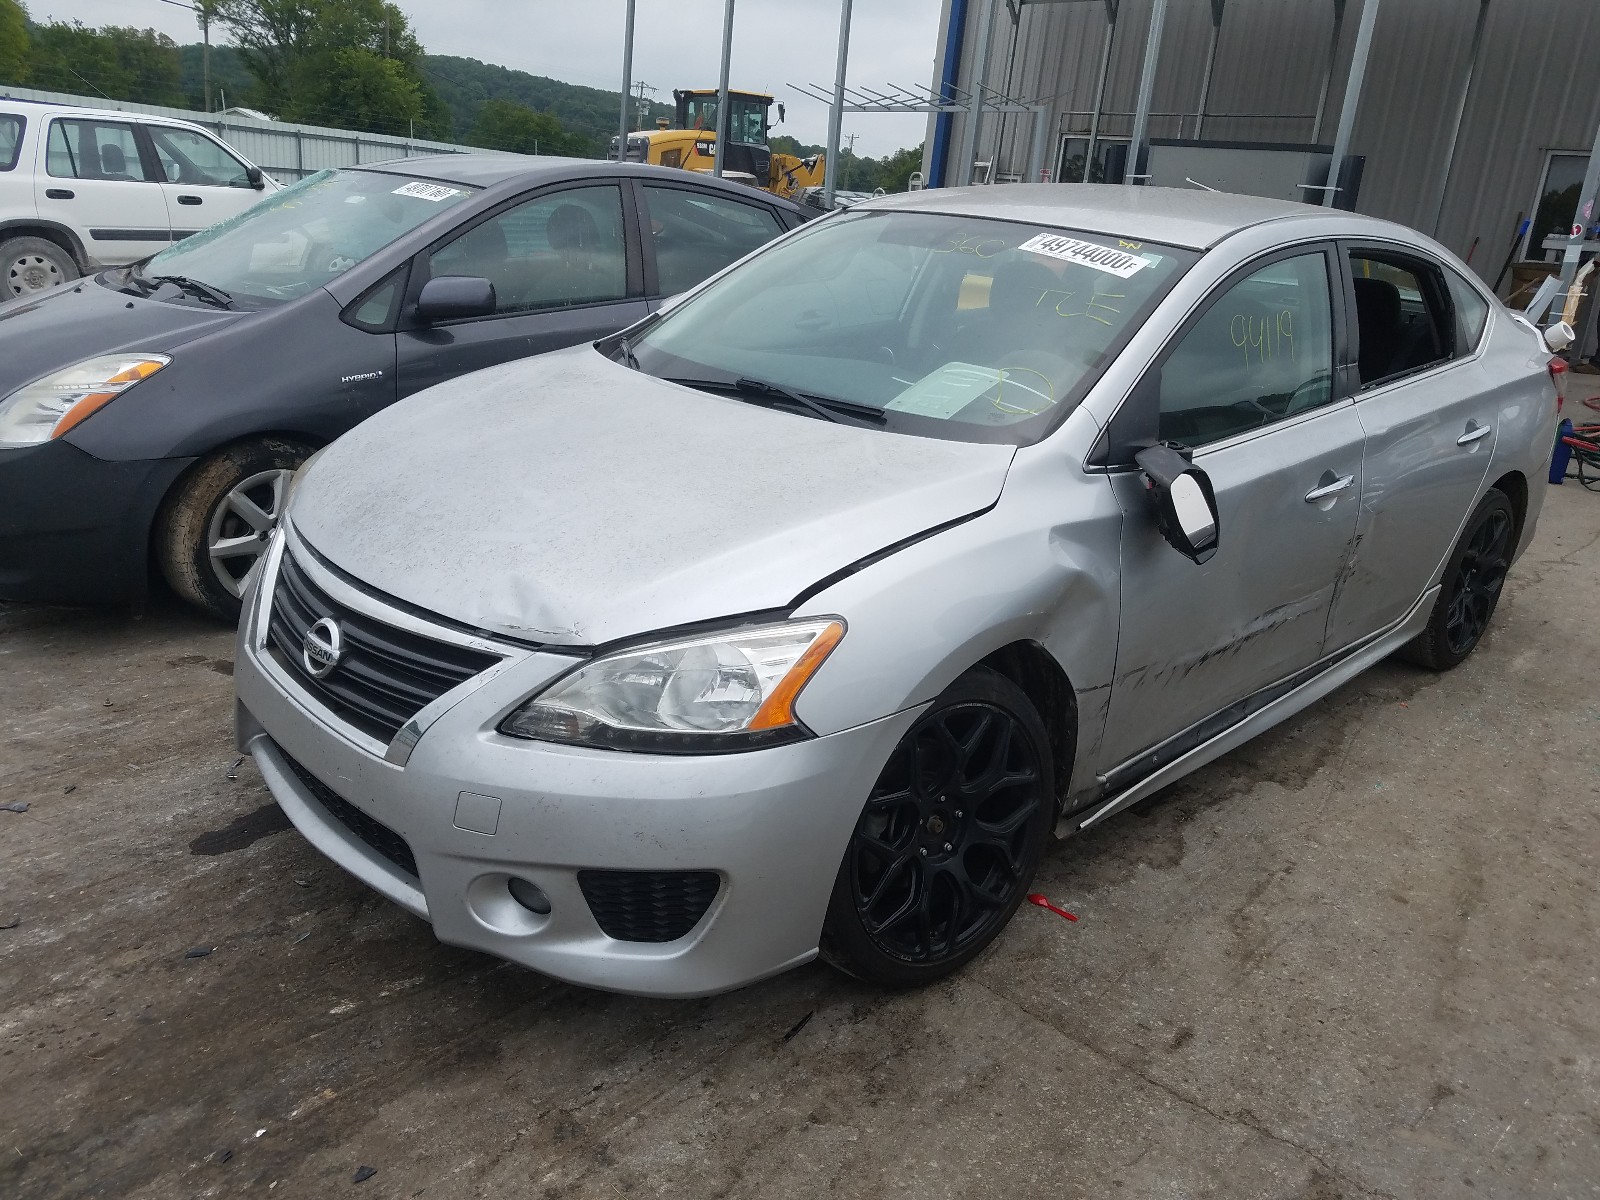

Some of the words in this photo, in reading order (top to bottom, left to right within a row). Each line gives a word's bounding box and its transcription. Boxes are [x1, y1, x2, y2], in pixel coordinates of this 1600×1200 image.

[1041, 237, 1134, 269] 49744000
[1230, 310, 1295, 371] 94119
[341, 371, 377, 383] HYBRID
